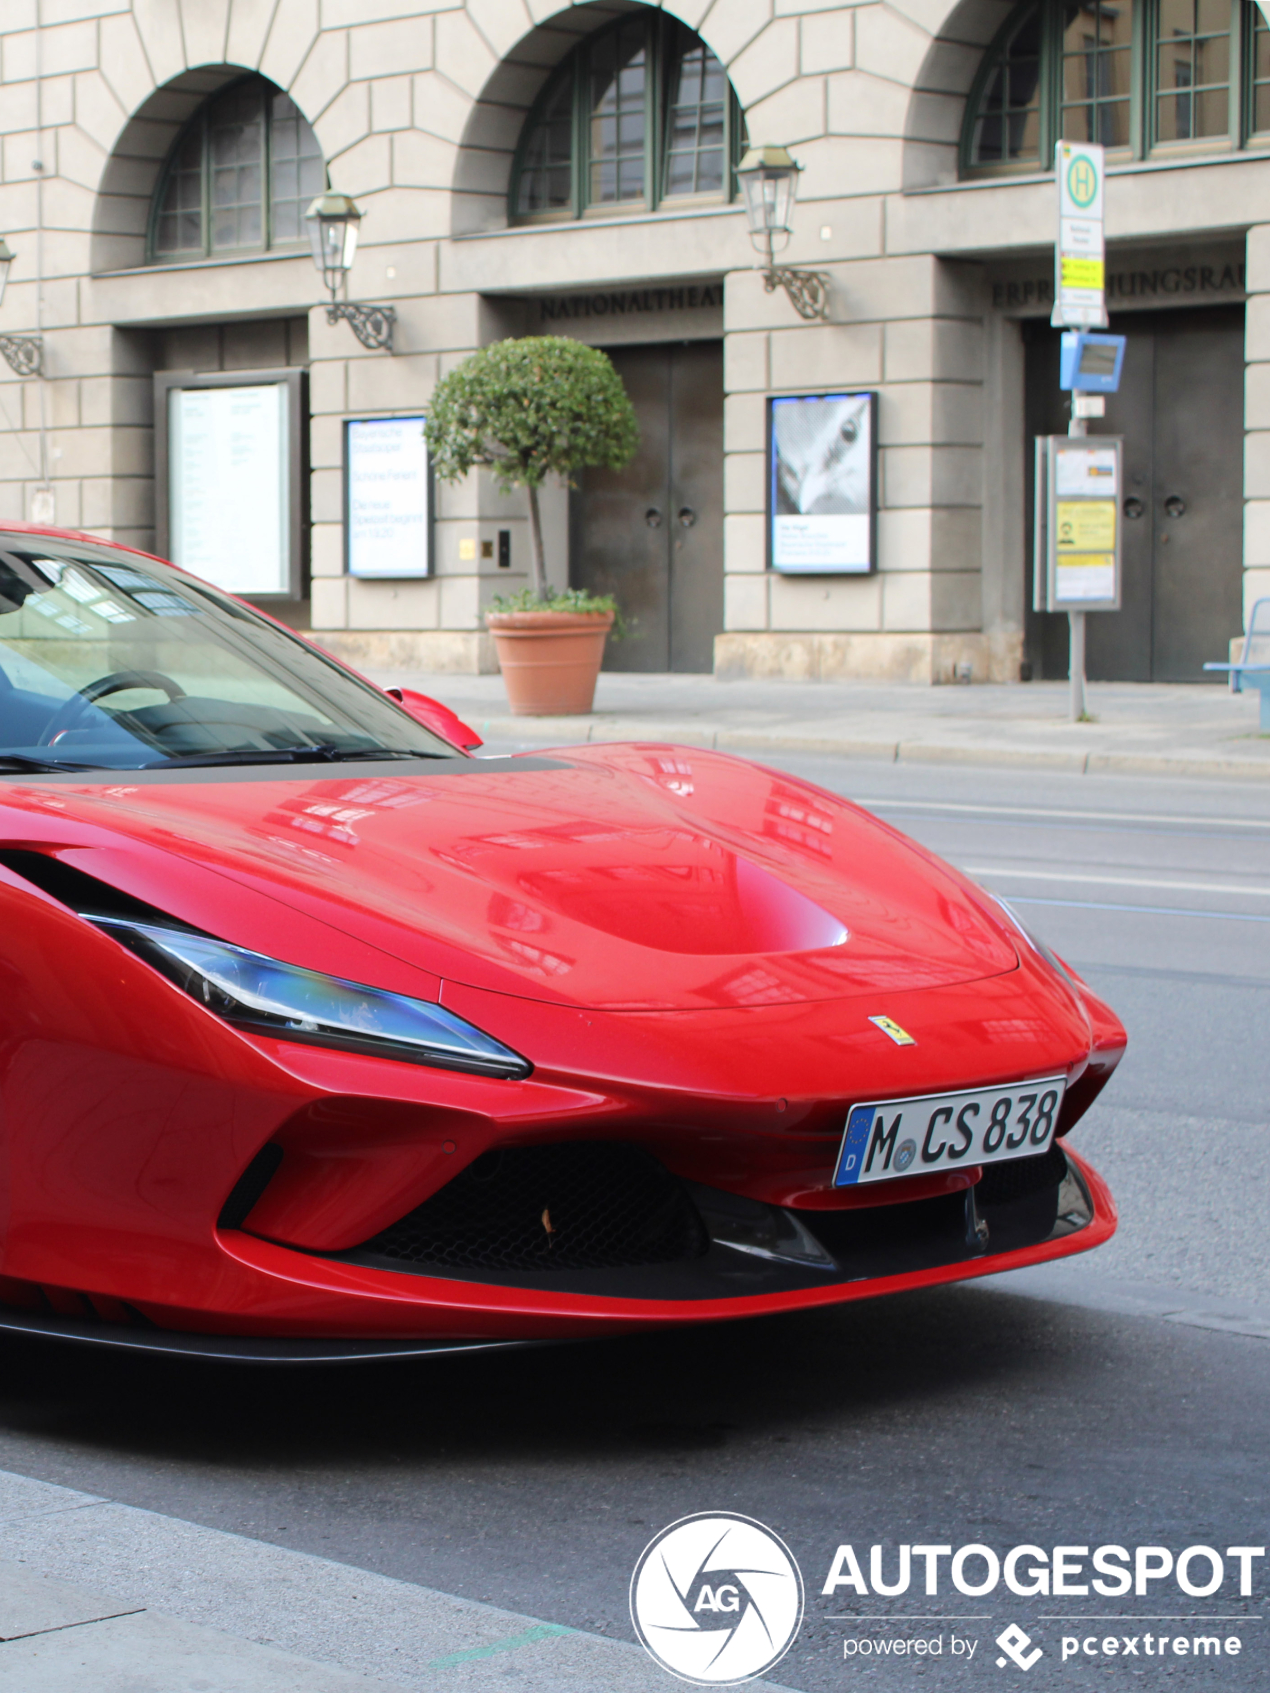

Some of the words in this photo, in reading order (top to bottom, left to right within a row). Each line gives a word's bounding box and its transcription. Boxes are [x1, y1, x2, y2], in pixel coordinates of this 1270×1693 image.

[1076, 166, 1090, 197] H
[845, 1154, 857, 1171] D
[864, 1112, 903, 1173] M
[921, 1102, 980, 1164] CS
[982, 1089, 1059, 1154] 838
